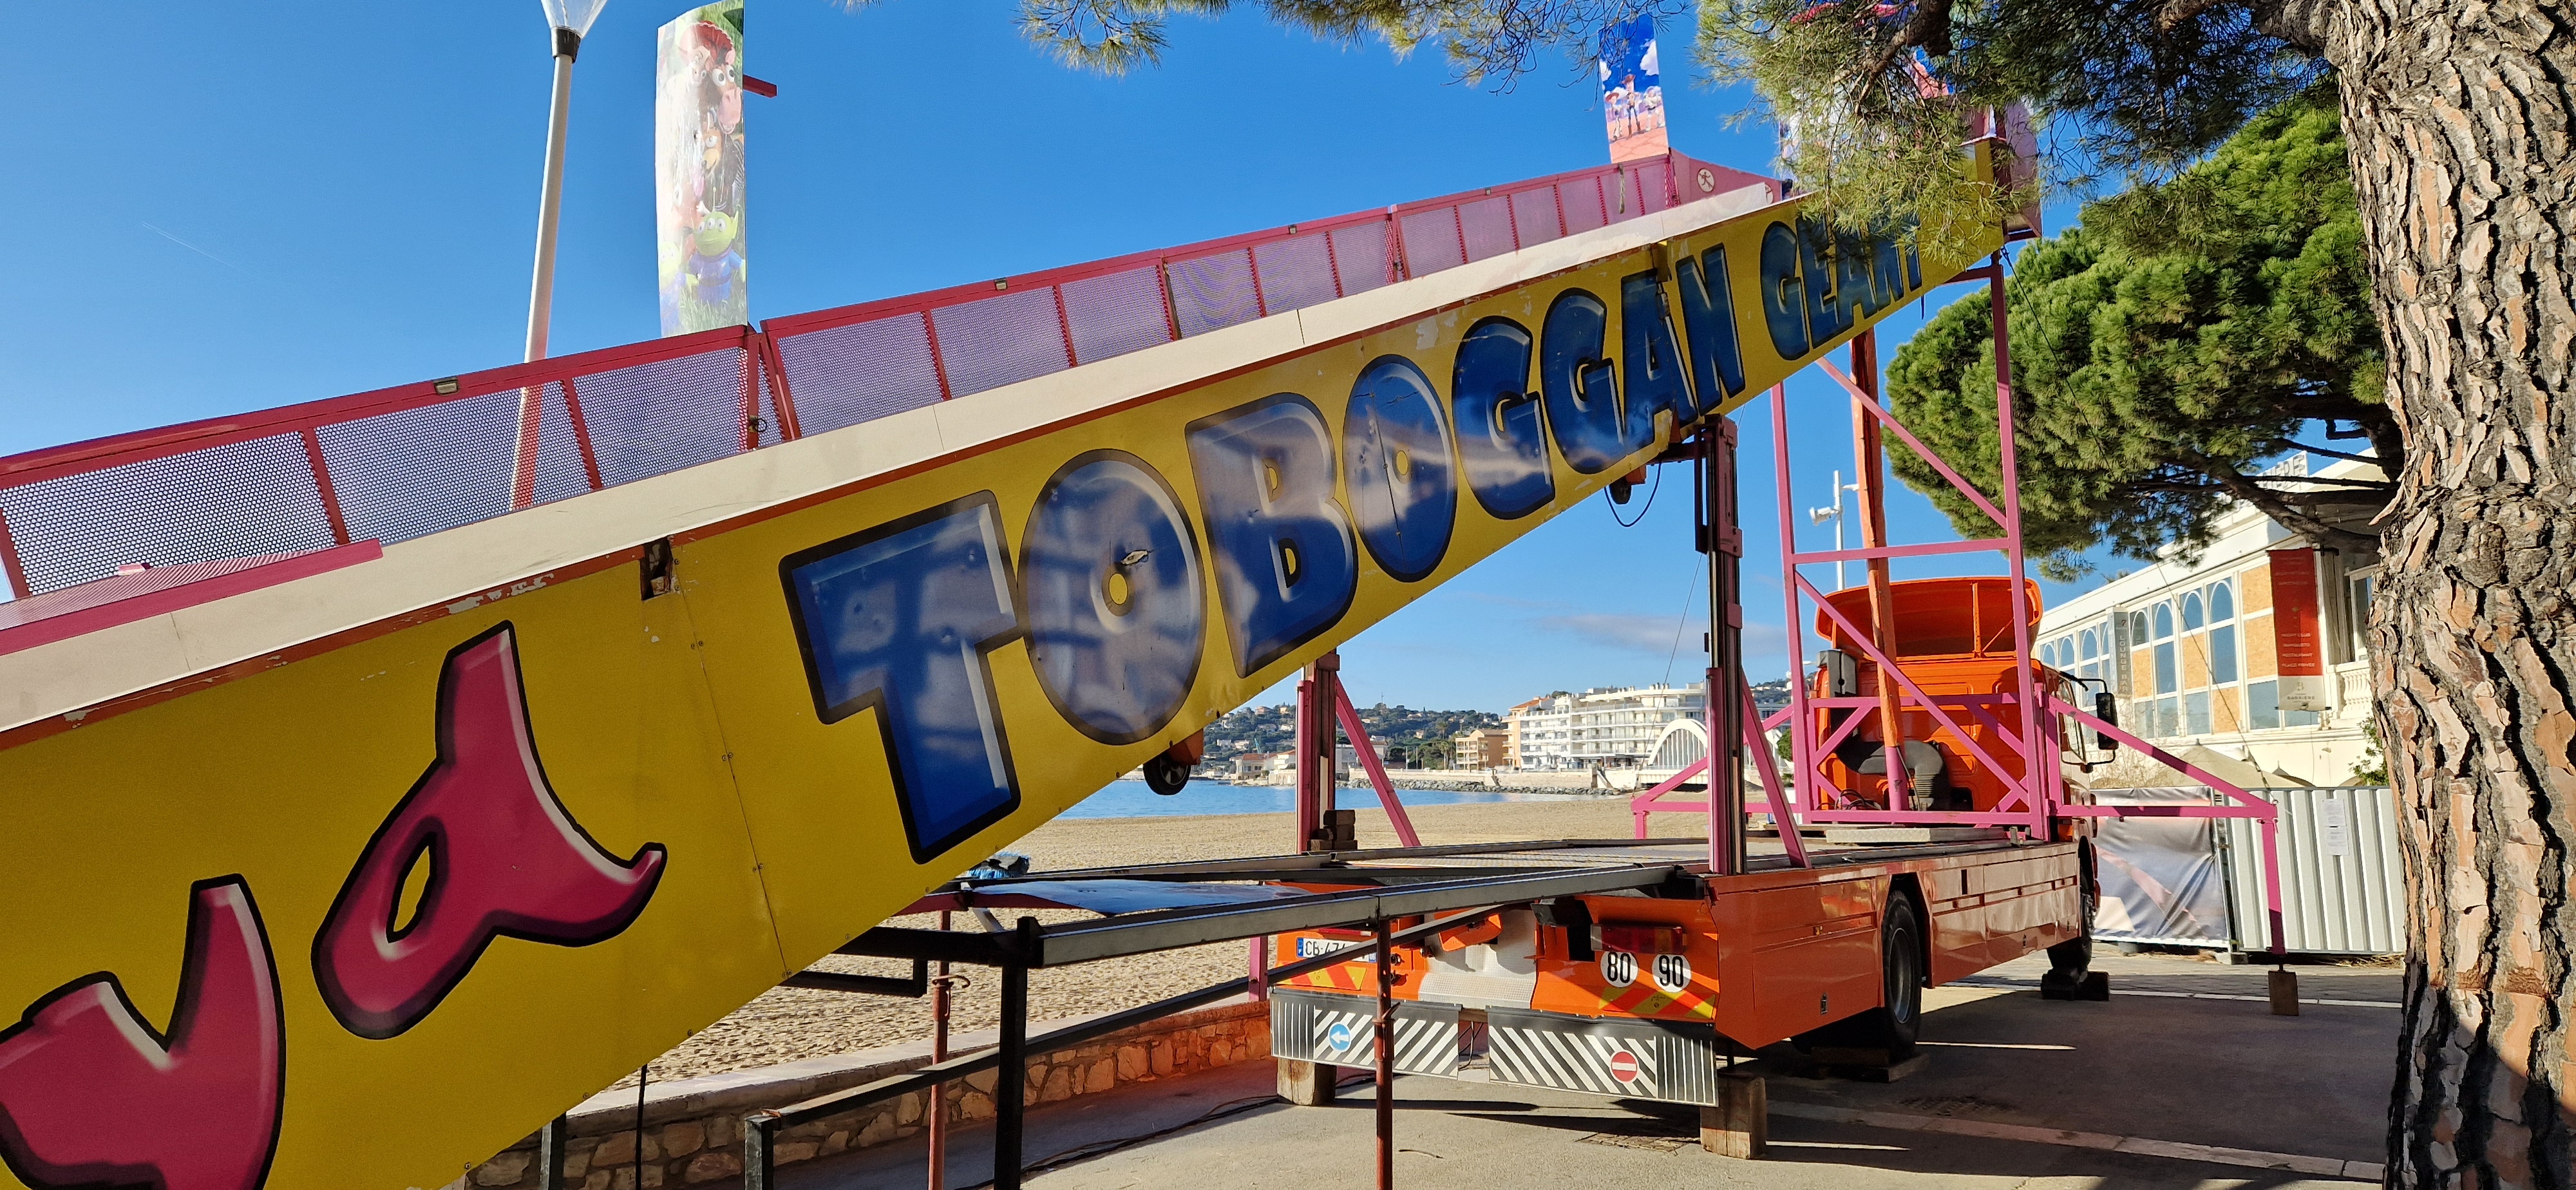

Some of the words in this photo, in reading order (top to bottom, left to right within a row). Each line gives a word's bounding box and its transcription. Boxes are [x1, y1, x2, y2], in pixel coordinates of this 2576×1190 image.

[778, 242, 1746, 865] TOBOGGAN
[1607, 951, 1631, 983] 80
[1658, 954, 1684, 988] 90
